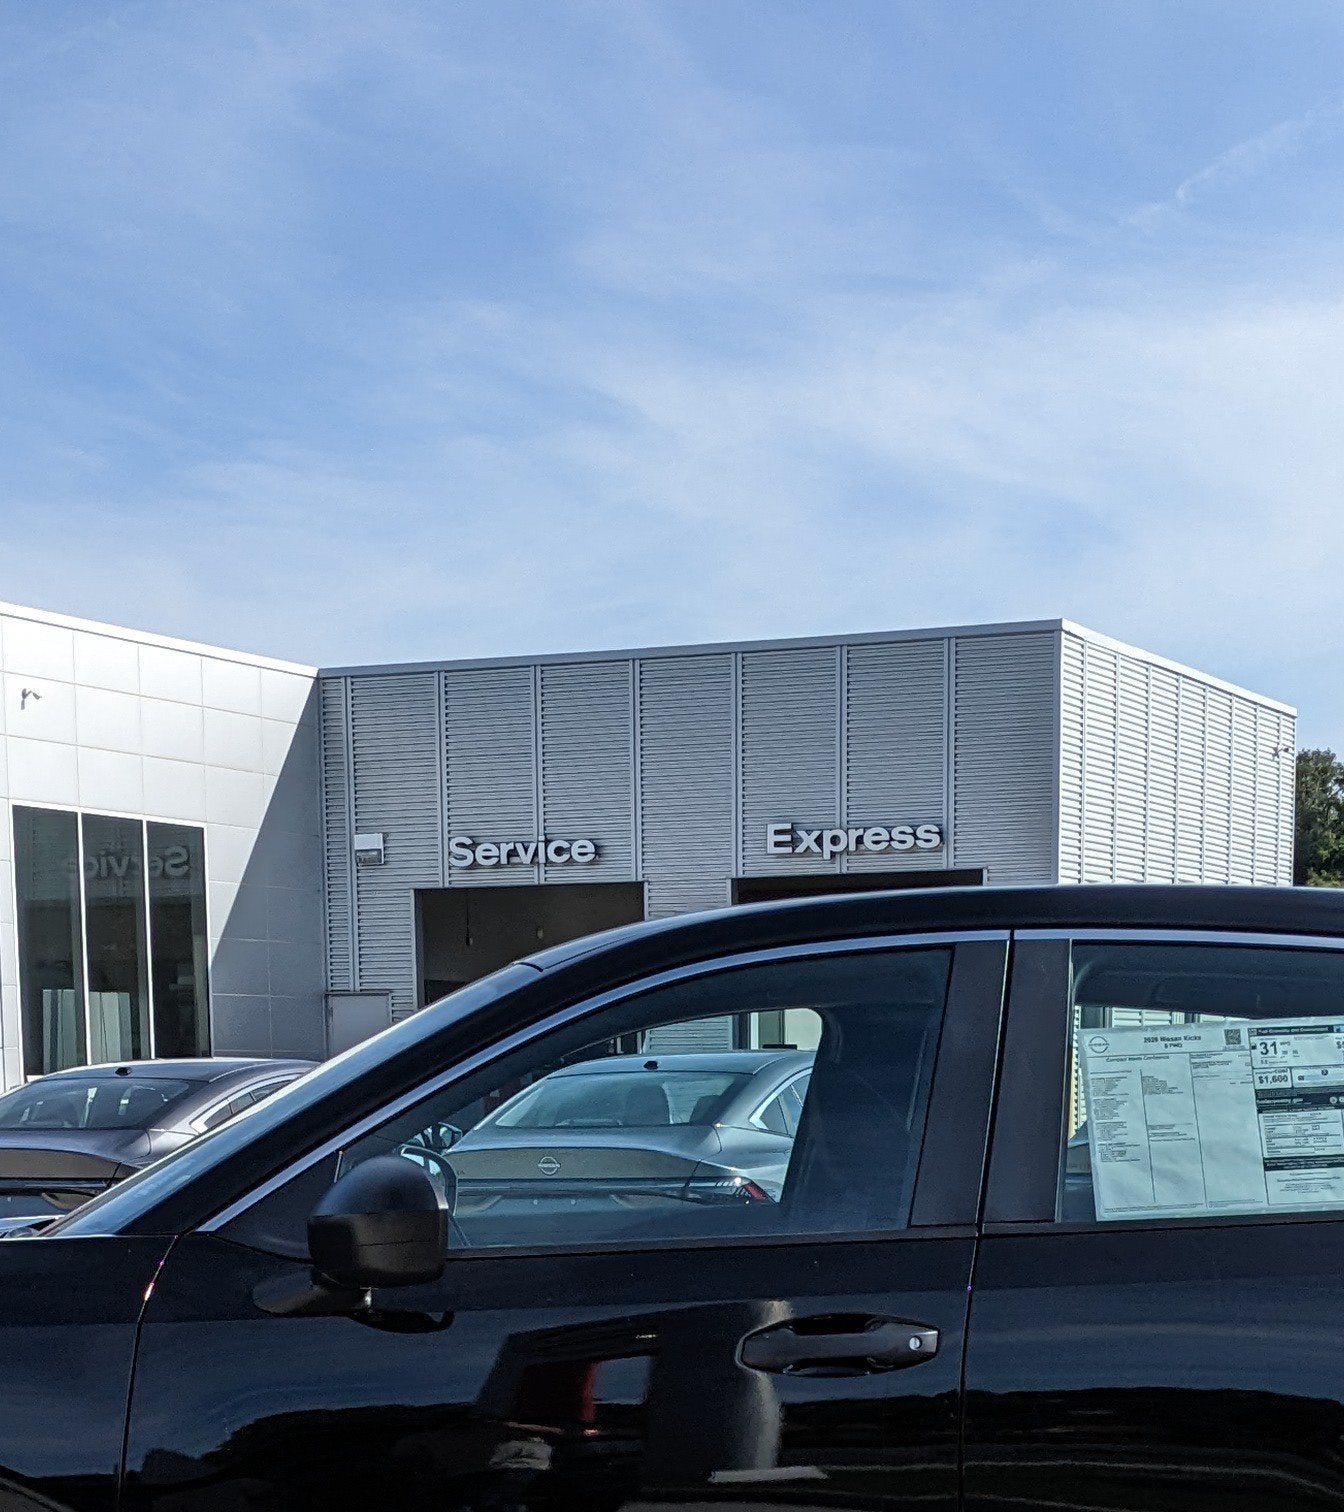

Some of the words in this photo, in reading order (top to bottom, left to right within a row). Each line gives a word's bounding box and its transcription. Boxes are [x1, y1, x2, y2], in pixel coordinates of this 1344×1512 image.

[449, 835, 598, 868] Service
[765, 822, 943, 860] Express
[1259, 1041, 1278, 1055] 31
